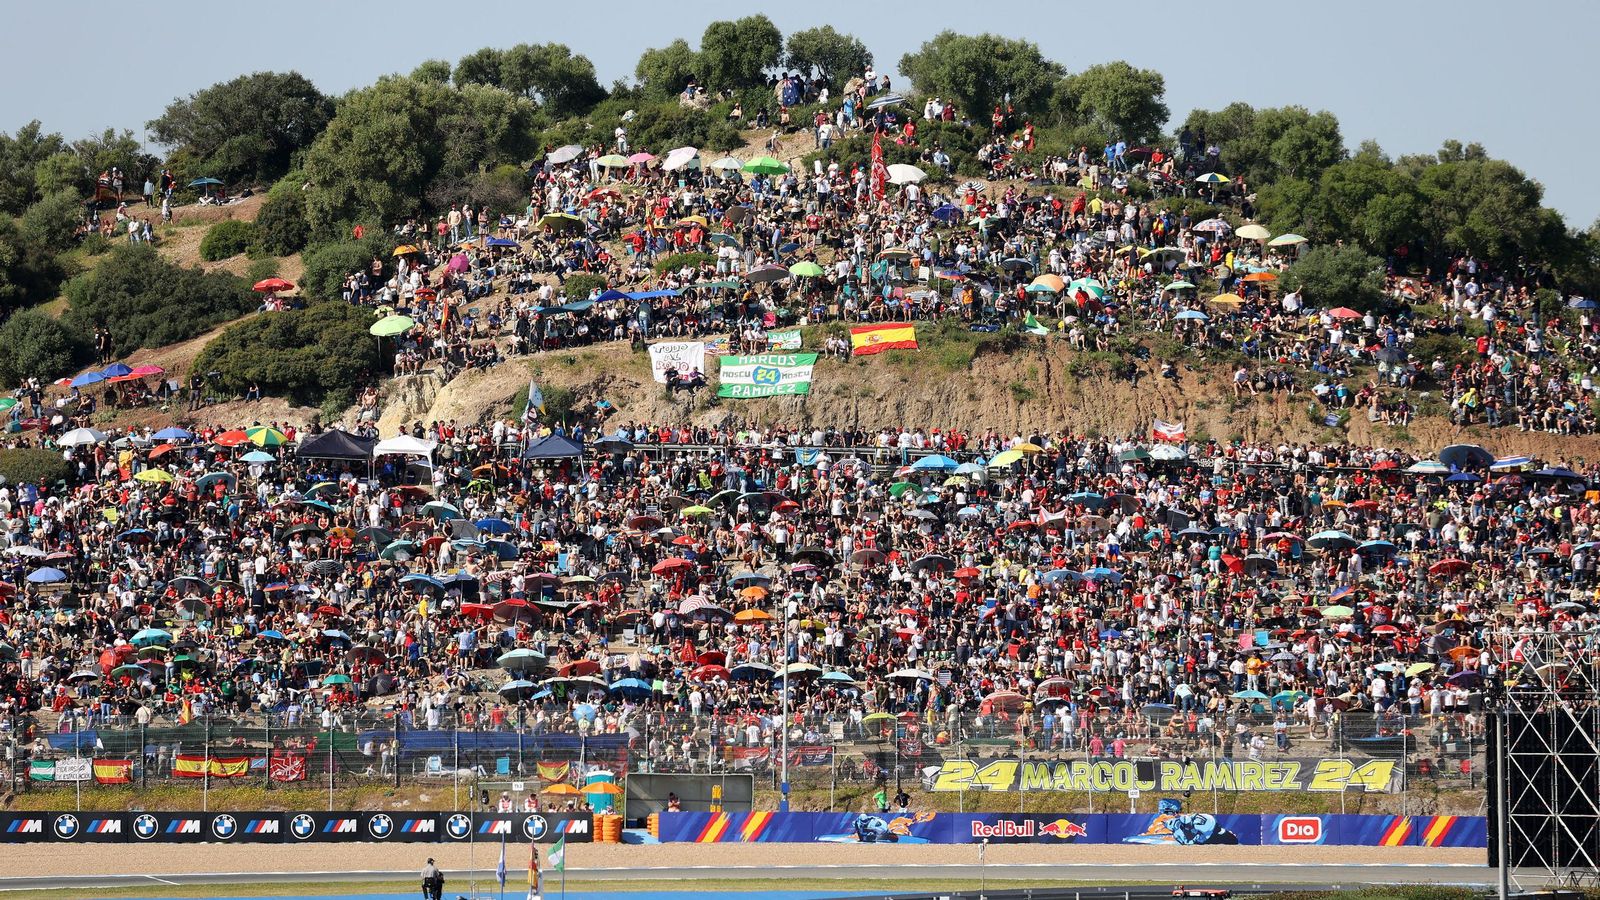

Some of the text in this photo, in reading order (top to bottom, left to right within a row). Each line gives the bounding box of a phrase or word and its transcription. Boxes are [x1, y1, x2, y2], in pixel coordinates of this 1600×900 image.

[739, 354, 797, 366] MARCOS
[756, 369, 776, 382] 24
[732, 384, 795, 396] RAMIREZ
[932, 760, 1019, 791] 24
[1161, 761, 1301, 790] RAMIREZ
[1308, 759, 1396, 791] 24
[972, 820, 1034, 836] Red Bull
